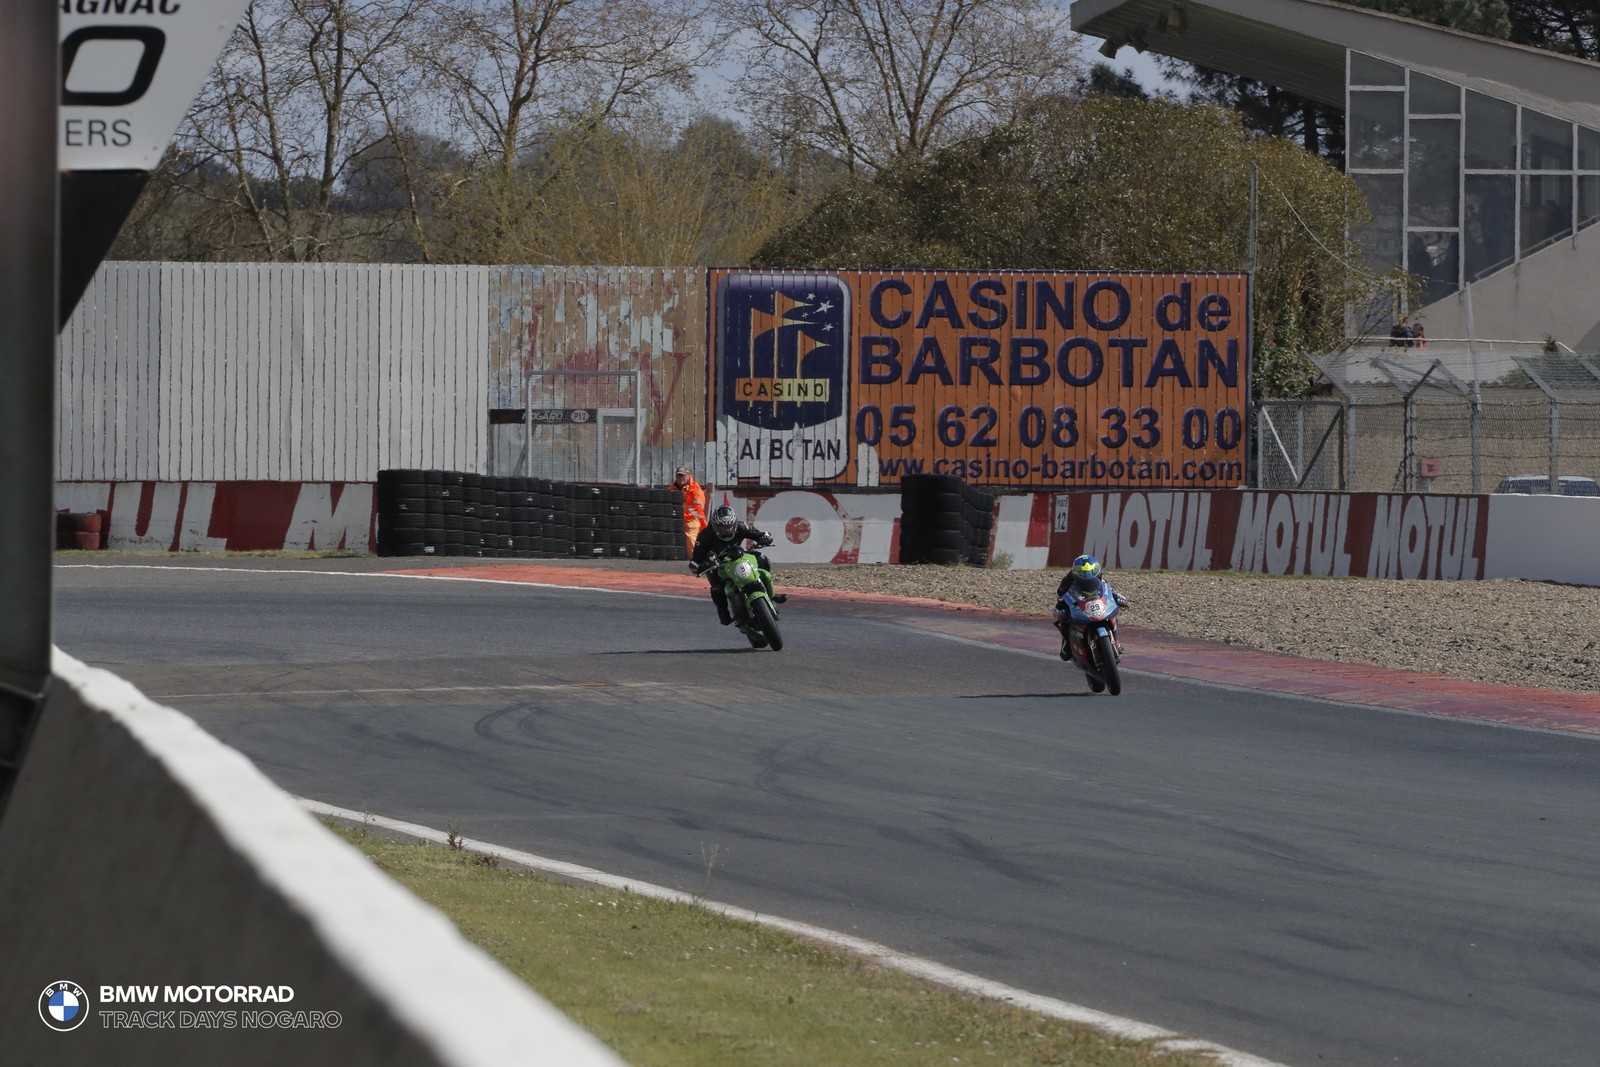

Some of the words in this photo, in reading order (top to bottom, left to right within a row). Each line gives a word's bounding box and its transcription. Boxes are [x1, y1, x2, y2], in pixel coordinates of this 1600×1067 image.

[869, 278, 1131, 330] CASINO
[1155, 281, 1231, 331] de
[859, 335, 1239, 389] BARBOTAN
[742, 382, 824, 397] CASINO
[855, 404, 917, 448] 05
[937, 405, 998, 448] 62
[1018, 406, 1078, 448] 08
[1100, 407, 1161, 449] 33
[1182, 407, 1242, 450] 00
[855, 451, 1243, 482] ww.casino-barbotan.com
[1057, 512, 1067, 530] 12
[1082, 492, 1213, 571] MOTUL
[1230, 492, 1352, 576] MOTUL
[1366, 494, 1479, 581] MOTUL
